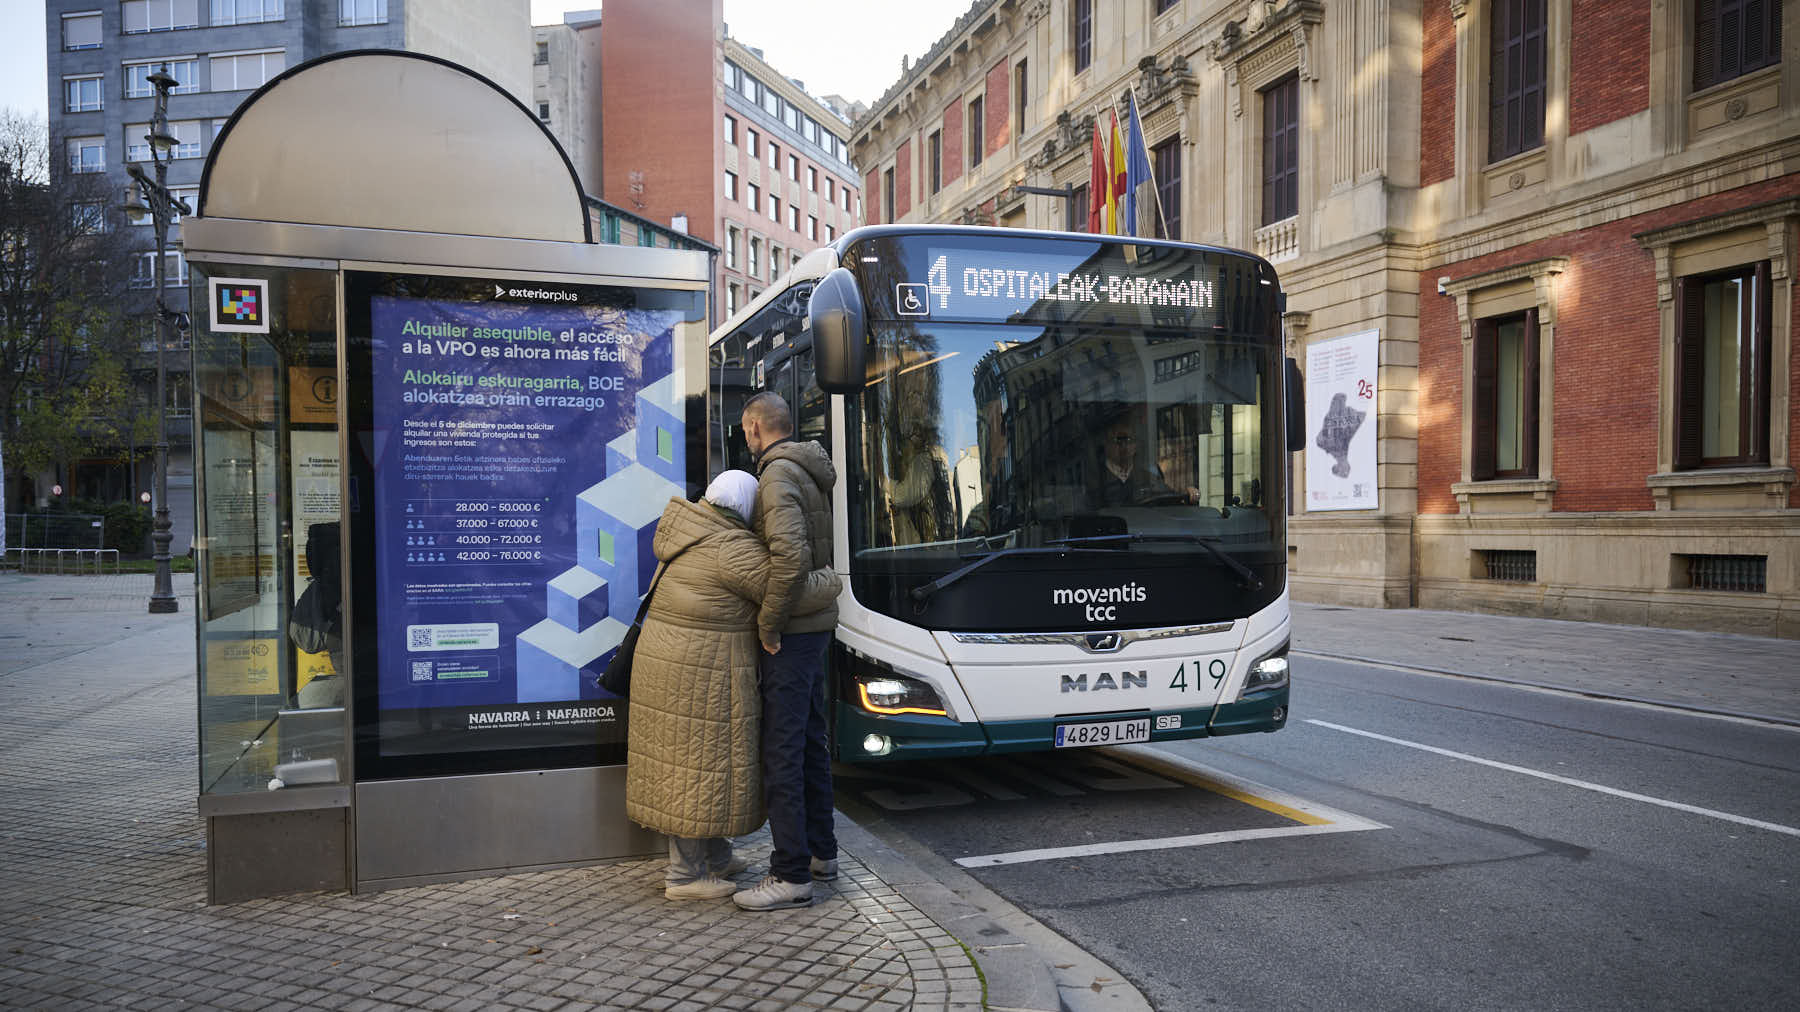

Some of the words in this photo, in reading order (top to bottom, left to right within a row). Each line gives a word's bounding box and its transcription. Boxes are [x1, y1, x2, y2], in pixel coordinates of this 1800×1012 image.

[928, 255, 951, 309] 4
[963, 266, 1214, 308] OSPITALEAK-BARAÑAIN
[508, 287, 578, 302] exteriorplus
[402, 320, 469, 339] Alquiler
[472, 325, 556, 344] asequible,
[559, 328, 574, 343] el
[578, 331, 633, 344] acceso
[402, 343, 413, 354] a
[417, 340, 432, 355] la
[435, 341, 477, 356] VPO
[480, 345, 500, 358] es
[503, 343, 551, 359] ahora
[555, 346, 589, 361] más
[593, 347, 626, 362] fácil
[402, 369, 474, 388] Alokairu
[478, 371, 585, 393] eskuragarria,
[588, 375, 625, 391] BOE
[1357, 378, 1374, 400] 25
[402, 388, 485, 406] alokatzea
[488, 392, 531, 407] orain
[534, 394, 606, 412] errazago
[403, 419, 430, 428] Desde
[430, 420, 438, 428] el
[445, 420, 457, 428] de
[457, 421, 496, 429] diciembre
[497, 422, 525, 431] puedes
[526, 422, 555, 430] solicitar
[403, 428, 432, 438] alquilar
[449, 429, 481, 438] vivienda
[481, 430, 518, 440] protegida
[519, 431, 526, 439] si
[527, 431, 540, 439] tus
[403, 437, 437, 448] ingresos
[438, 439, 453, 447] son
[453, 439, 477, 447] estos:
[455, 503, 489, 512] 28.000
[499, 503, 532, 512] 50.000
[533, 503, 541, 512] €
[455, 519, 488, 528] 37.000
[497, 519, 530, 528] 67.000
[530, 519, 538, 528] €
[455, 535, 491, 544] 40.000
[500, 535, 533, 544] 72.000
[534, 535, 542, 544] €
[455, 551, 490, 561] 42.000
[499, 551, 532, 560] 76.000
[533, 551, 542, 560] €
[1053, 581, 1147, 605] moventis
[1085, 603, 1117, 622] tcc
[1060, 670, 1148, 694] MAN
[1168, 658, 1227, 693] 419
[468, 710, 531, 724] NAVARRA
[546, 706, 616, 721] NAFARROA
[1158, 716, 1180, 728] SP
[1067, 725, 1110, 745] 4829
[1115, 721, 1146, 742] LRH
